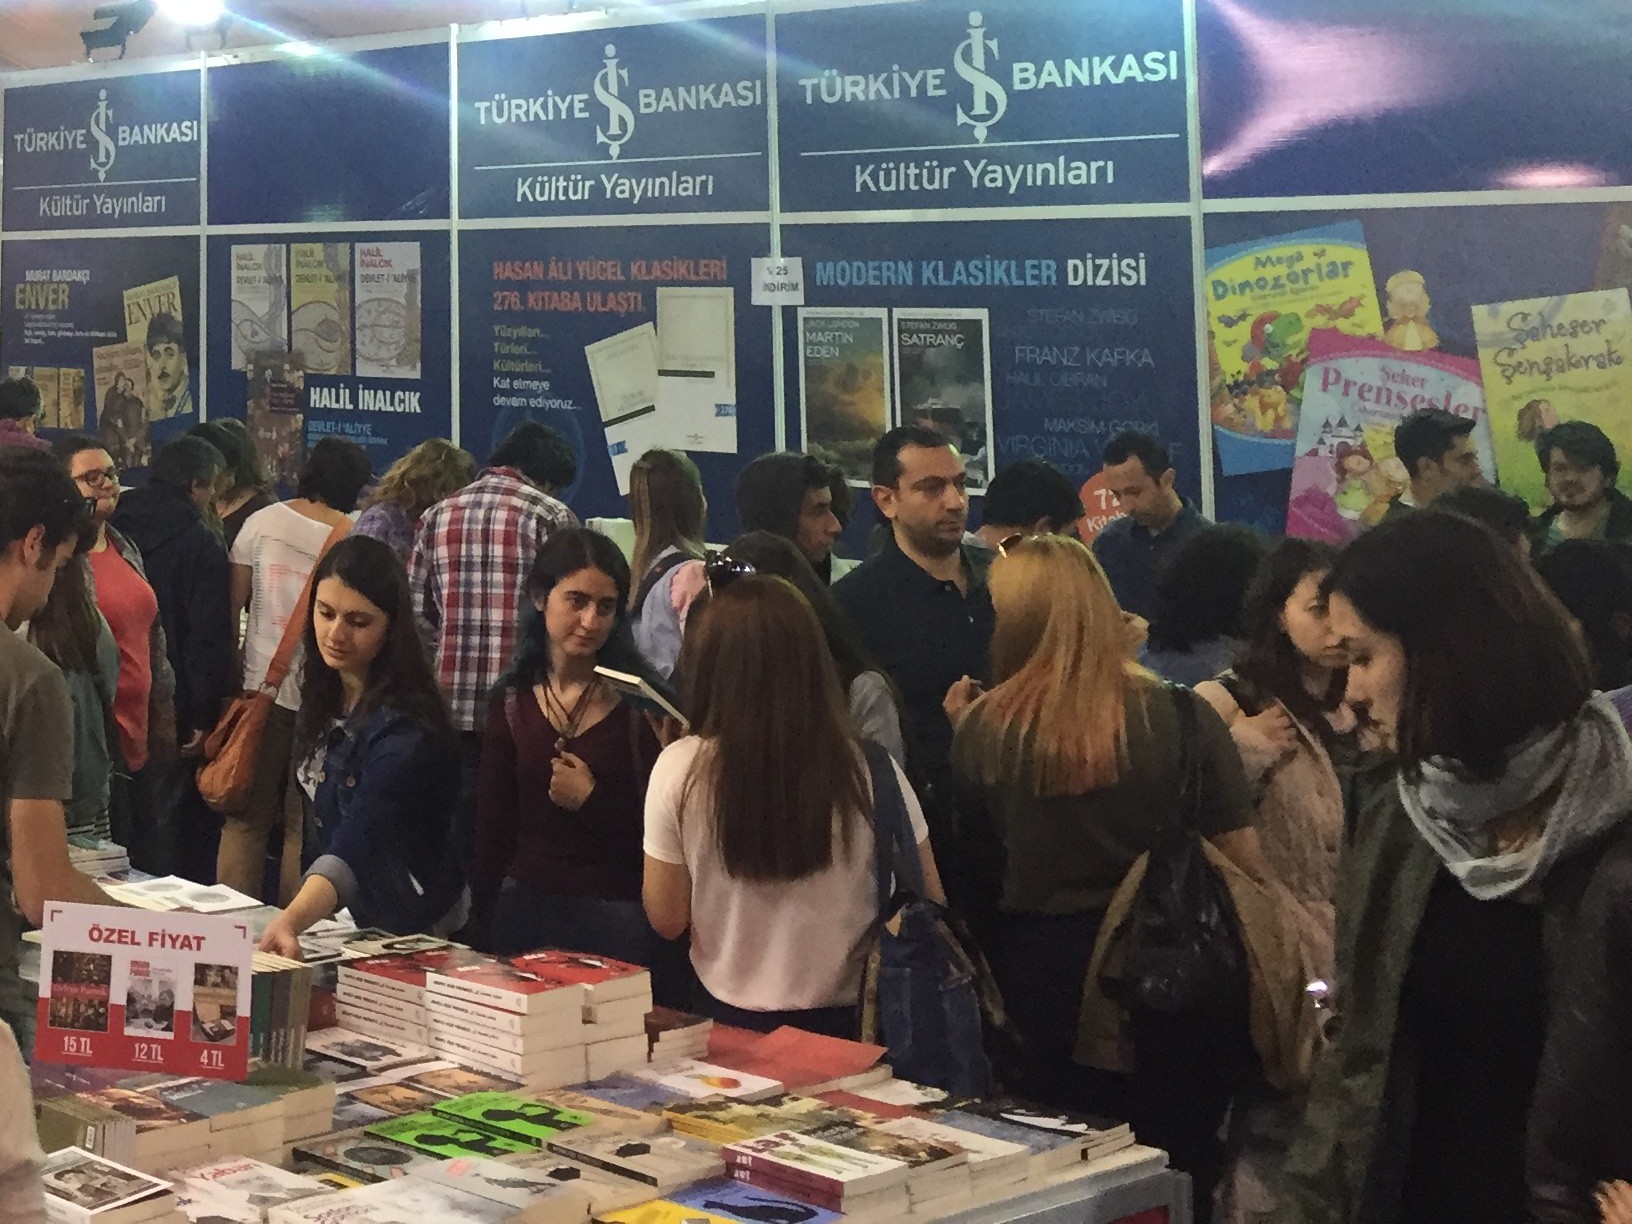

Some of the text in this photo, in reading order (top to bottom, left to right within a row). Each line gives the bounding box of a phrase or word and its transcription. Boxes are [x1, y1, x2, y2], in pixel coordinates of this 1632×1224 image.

[798, 64, 947, 105] TÜRKİYE
[1011, 50, 1178, 91] BANKASI
[474, 89, 590, 125] TÜRKİYE
[638, 79, 762, 114] BANKASI
[14, 126, 87, 152] TÜRKİYE
[118, 120, 198, 146] BANKASI
[516, 171, 714, 204] Kültür Yayınları
[854, 156, 1115, 194] Kültür Yayınları
[39, 192, 165, 218] Kültür Yayınları
[493, 260, 544, 281] HASAN
[815, 252, 1146, 287] MODERN KLASİKLER DİZİSİ
[15, 283, 70, 310] ENVER
[127, 291, 179, 326] ENVER
[806, 331, 854, 344] MARTIN
[900, 333, 965, 350] SATRANÇ
[806, 346, 840, 358] EDEN
[1015, 346, 1155, 368] FRANZ KAFKA
[310, 383, 354, 410] HALİL
[359, 383, 422, 413] İNALCIK
[493, 377, 550, 394] Kat etmeye
[493, 394, 527, 407] devam
[88, 923, 206, 952] ÖZEL FİYAT
[63, 1035, 93, 1054] 15 TL
[134, 1043, 164, 1061] 12 TL
[200, 1049, 225, 1067] 4 TL
